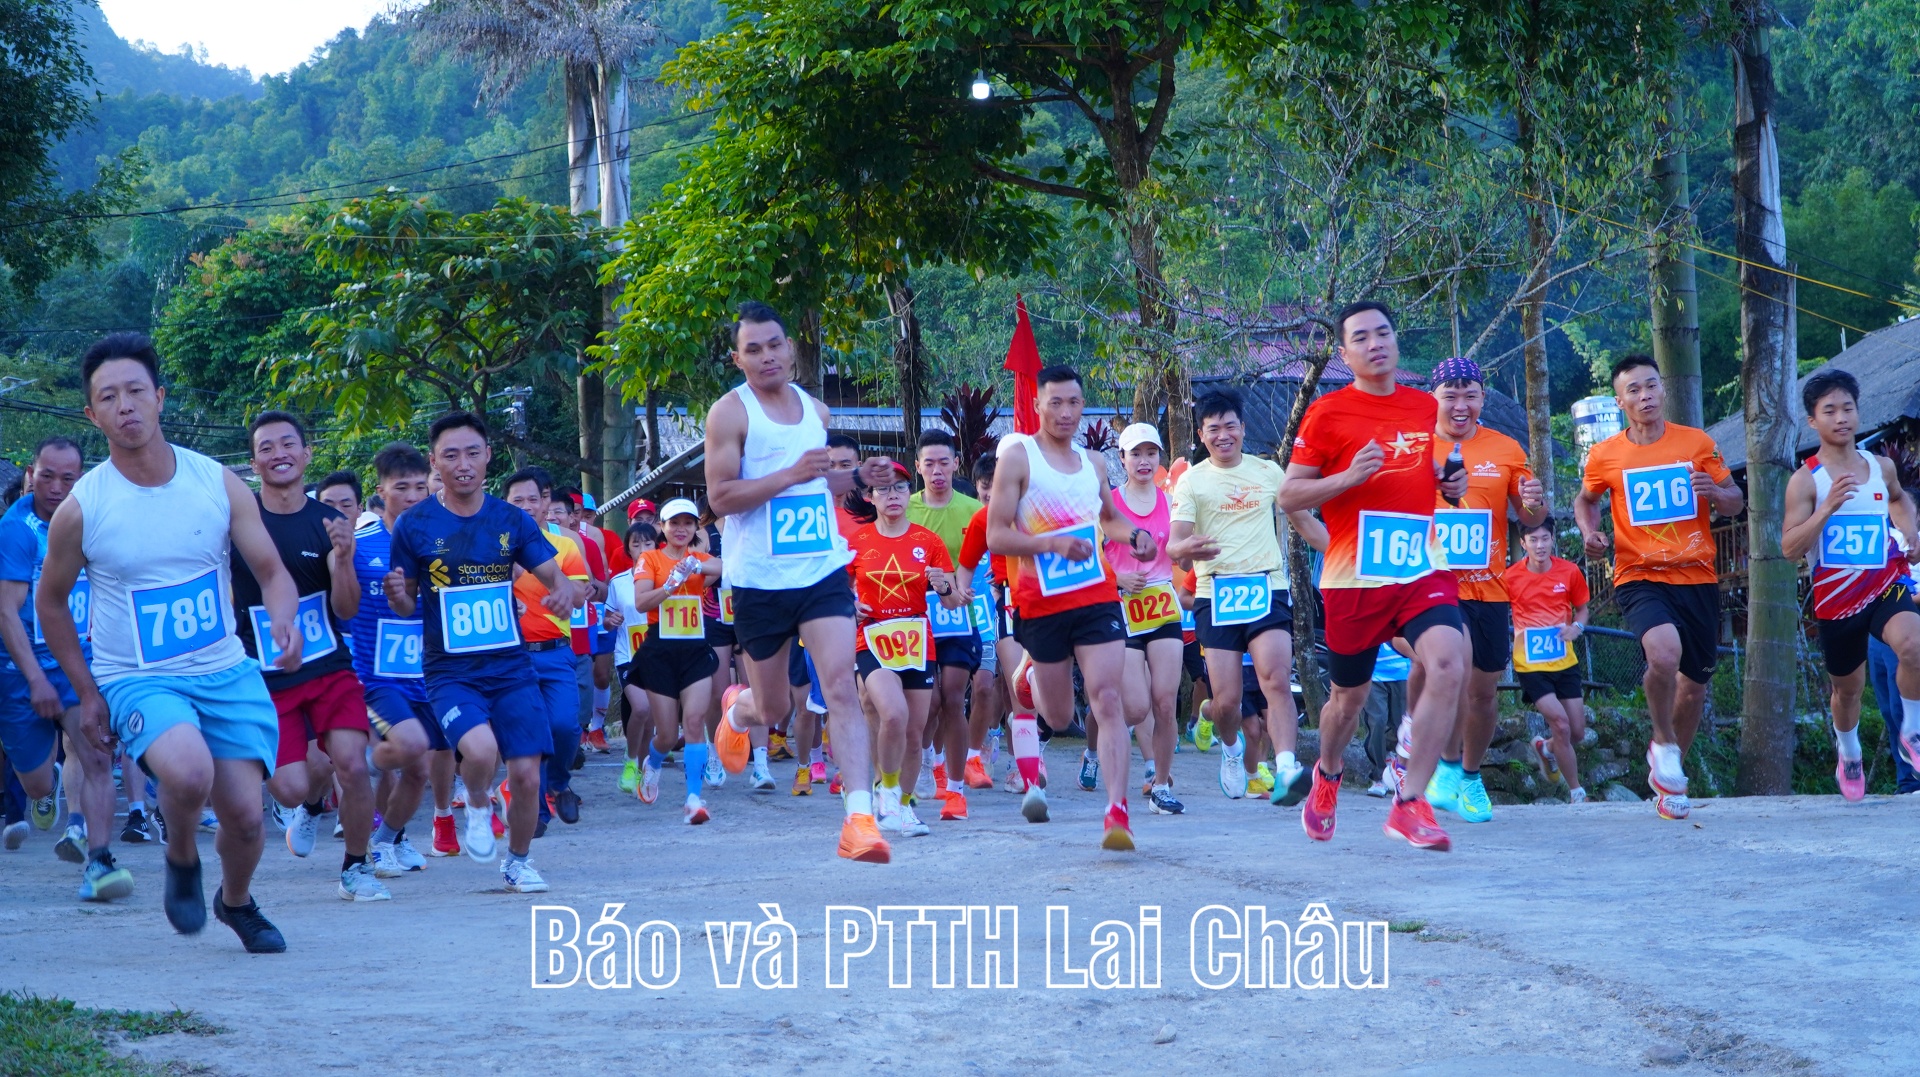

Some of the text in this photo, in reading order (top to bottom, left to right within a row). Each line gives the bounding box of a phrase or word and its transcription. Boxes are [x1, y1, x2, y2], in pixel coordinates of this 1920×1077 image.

[1220, 500, 1260, 511] FINISHER
[1633, 477, 1688, 512] 216
[776, 505, 828, 543] 226
[1436, 523, 1485, 555] 208
[1369, 528, 1423, 567] 169
[1827, 525, 1880, 555] 257
[458, 563, 510, 574] standard
[459, 573, 509, 585] chartered
[1128, 592, 1175, 623] 022
[1218, 585, 1266, 613] 222
[141, 588, 218, 647] 789
[451, 598, 509, 636] 800
[665, 606, 698, 628] 116
[385, 634, 423, 665] 79
[875, 629, 920, 661] 092
[1531, 635, 1562, 655] 241
